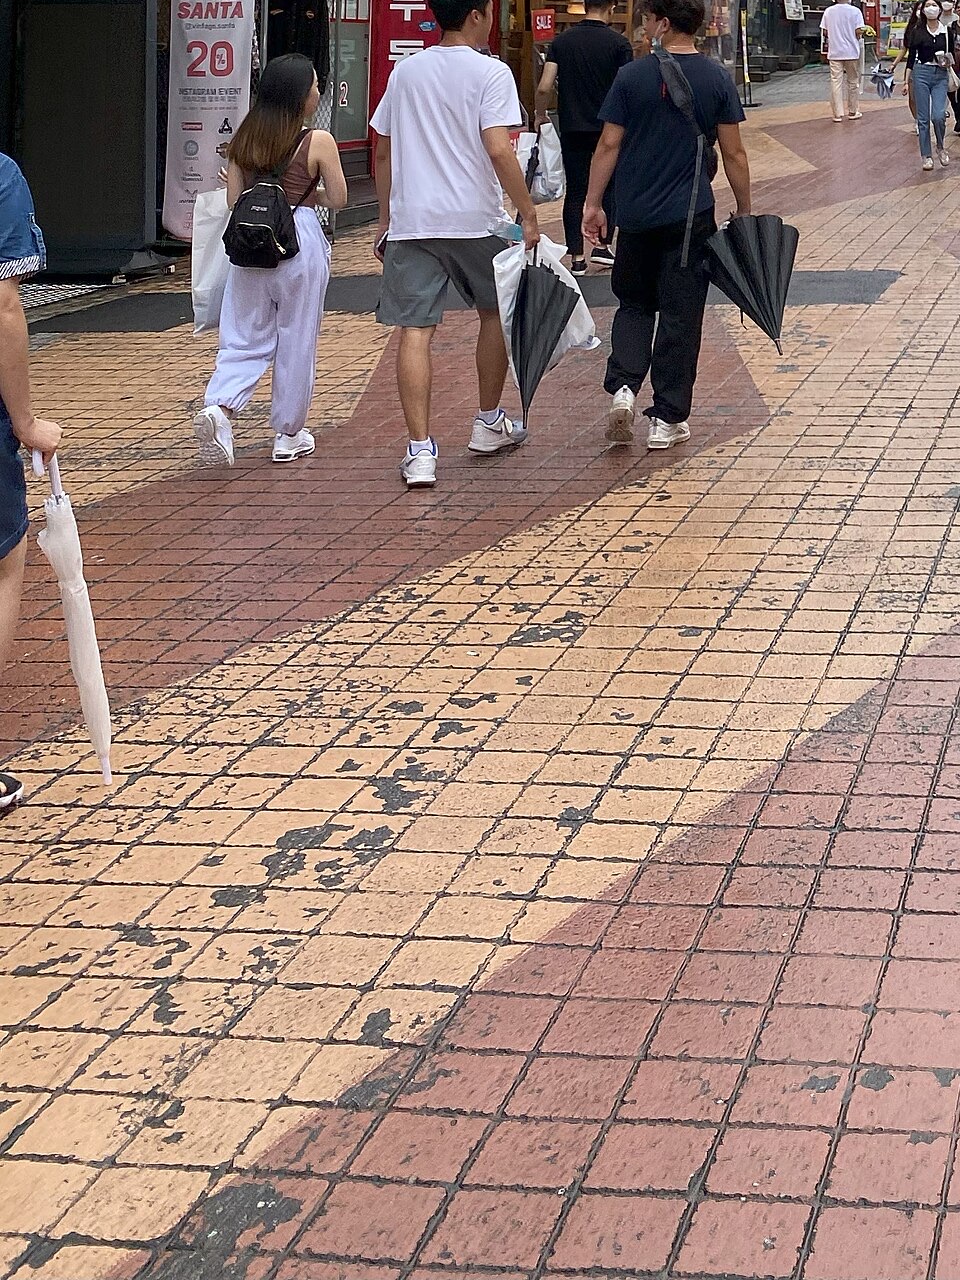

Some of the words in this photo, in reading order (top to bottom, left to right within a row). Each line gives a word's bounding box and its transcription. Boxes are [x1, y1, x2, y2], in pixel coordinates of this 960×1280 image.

[177, 1, 244, 19] SANTA
[536, 15, 552, 30] SALE
[186, 41, 234, 77] 20
[218, 87, 242, 95] EVENT
